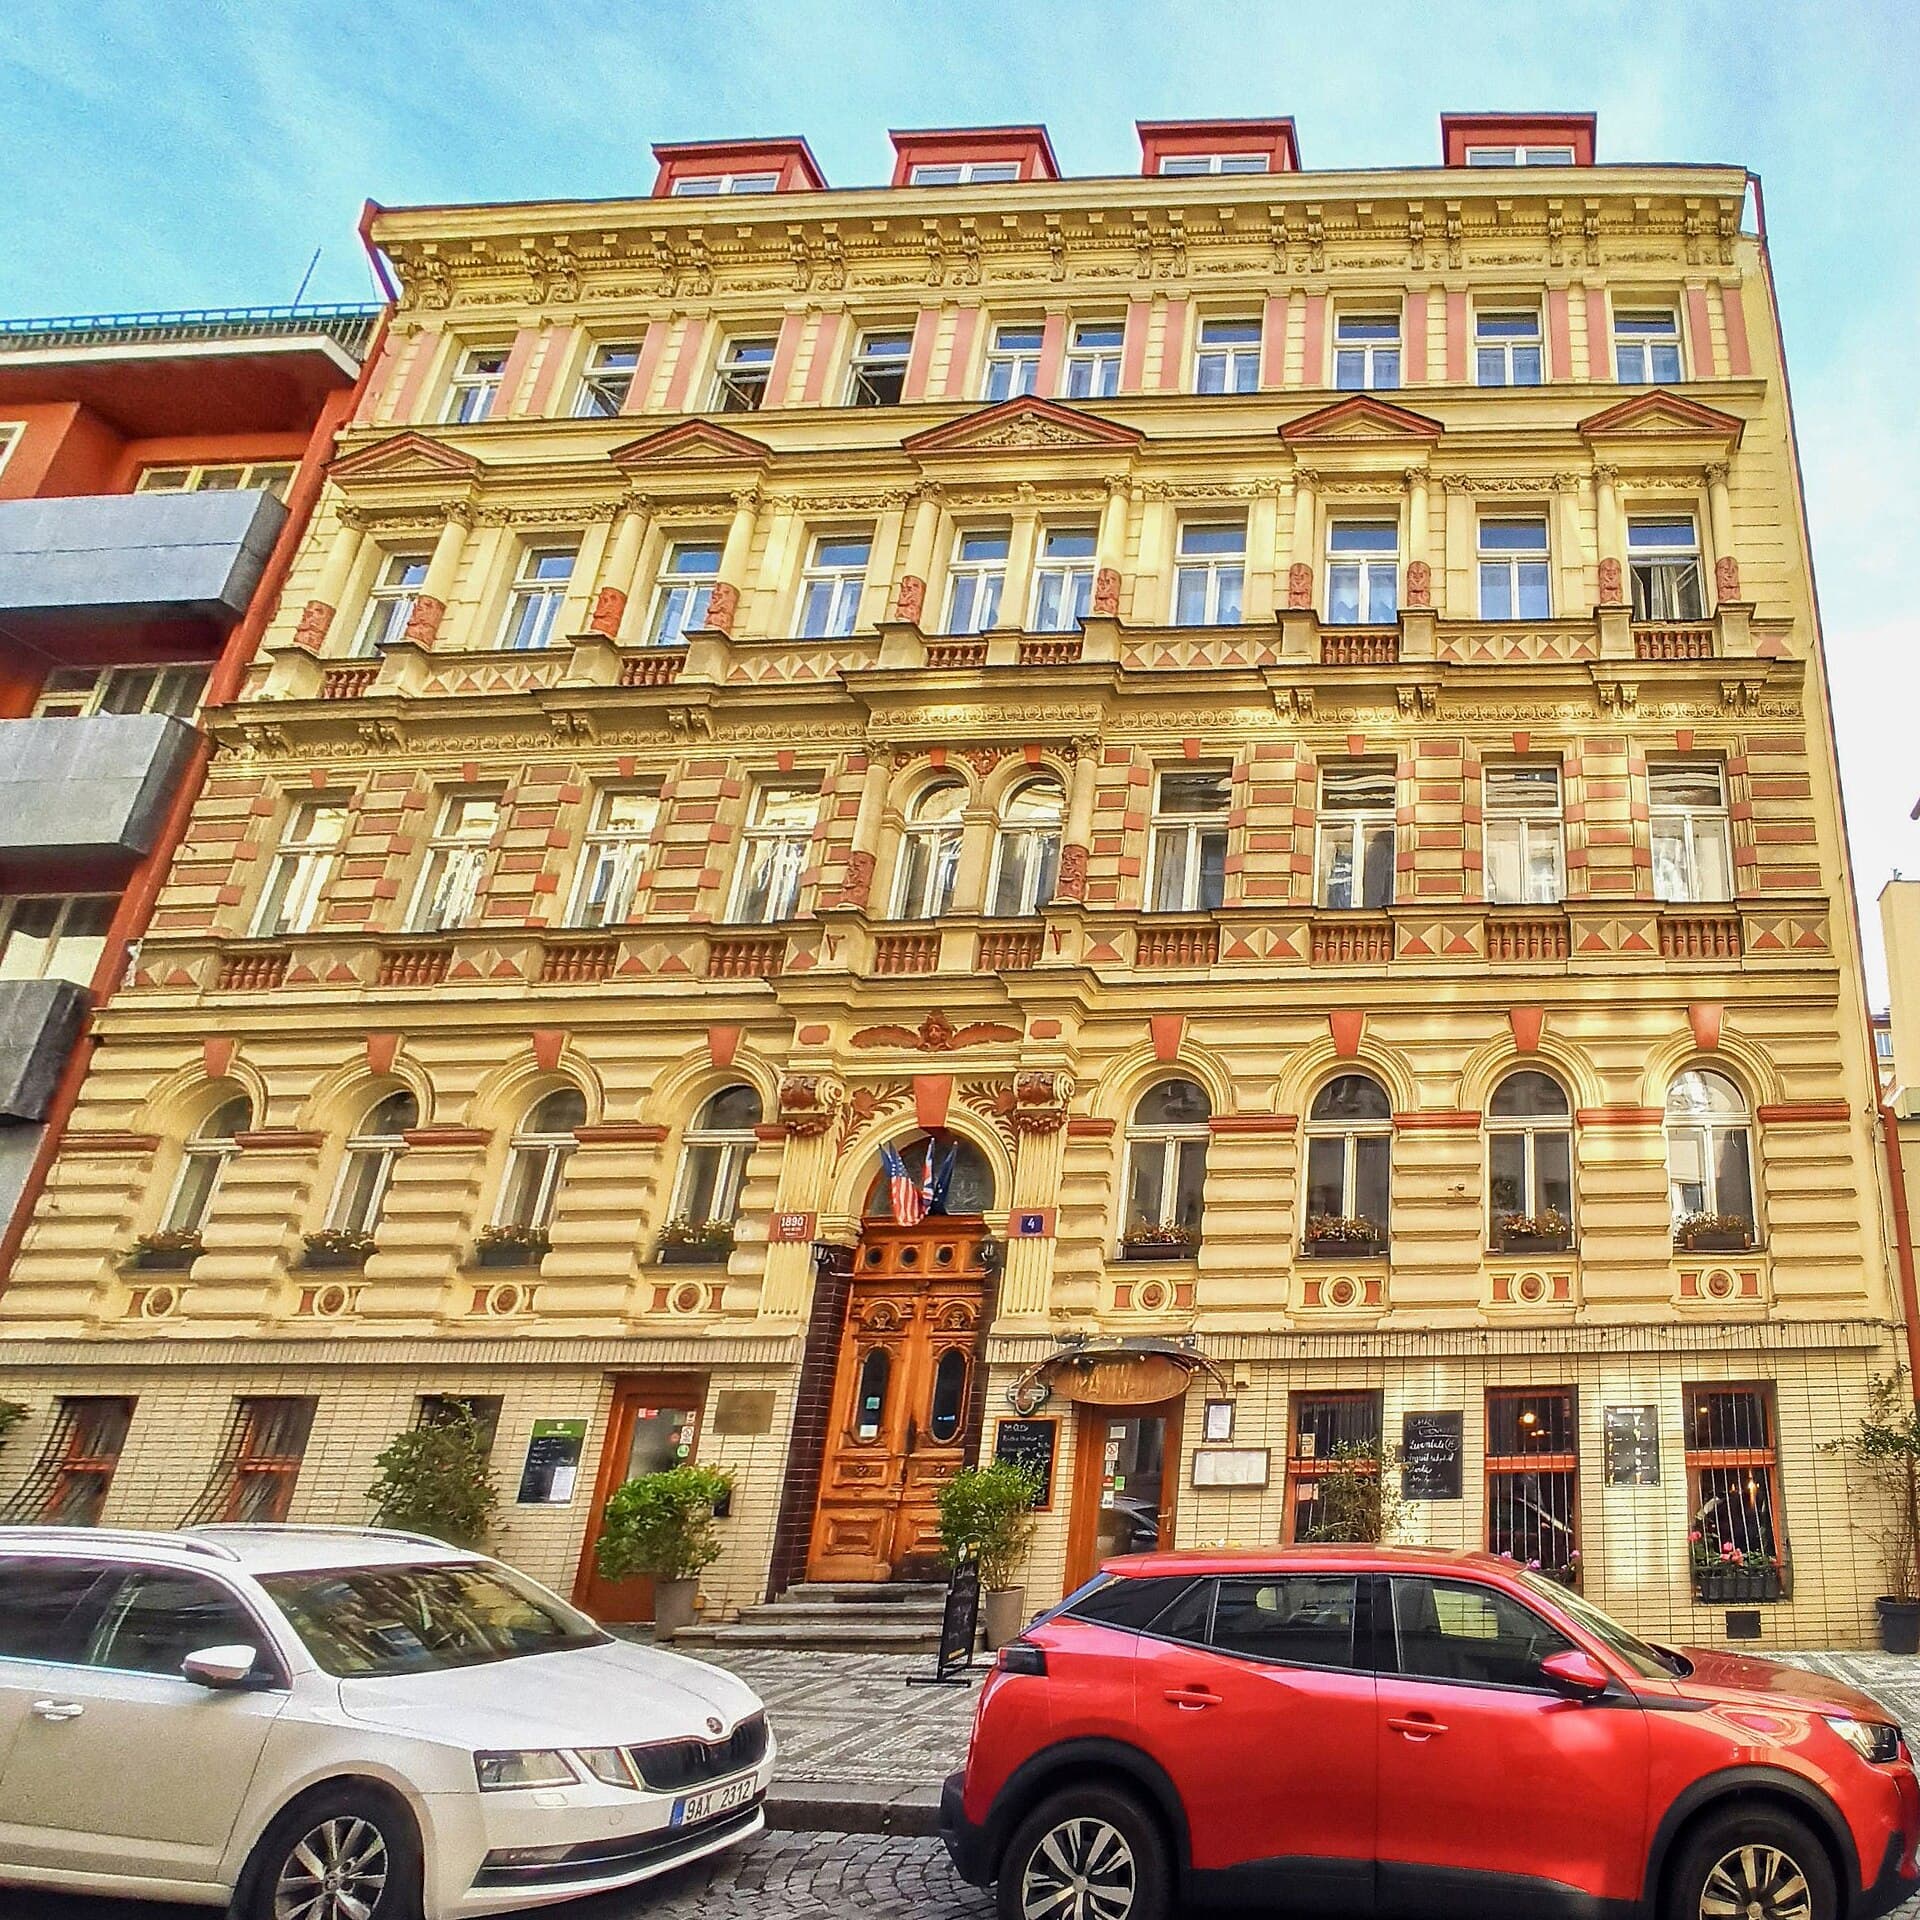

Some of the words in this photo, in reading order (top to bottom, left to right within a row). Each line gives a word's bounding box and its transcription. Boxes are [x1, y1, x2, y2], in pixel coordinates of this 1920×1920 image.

[781, 1216, 804, 1228] 1890
[1027, 1216, 1035, 1229] 4
[686, 1794, 712, 1821] 9AX
[720, 1780, 751, 1809] 2312
